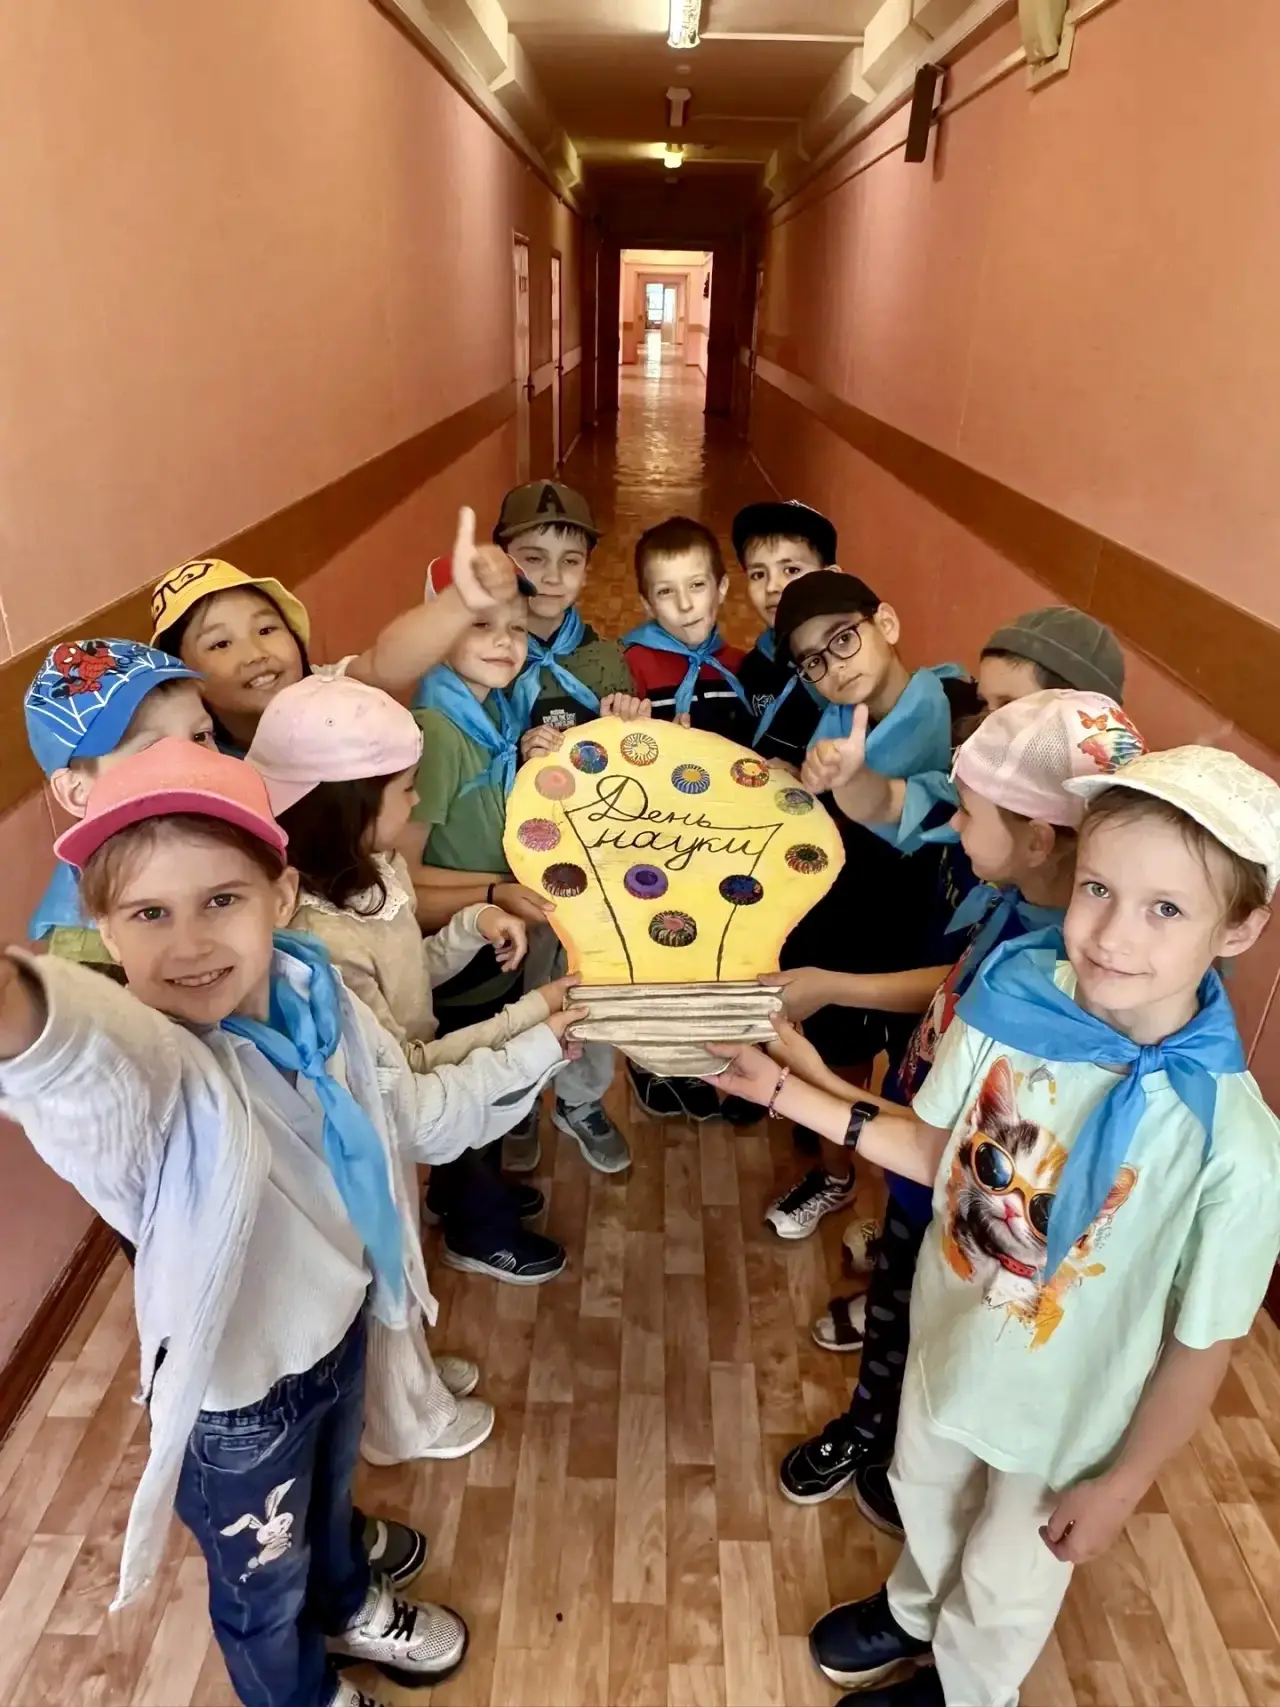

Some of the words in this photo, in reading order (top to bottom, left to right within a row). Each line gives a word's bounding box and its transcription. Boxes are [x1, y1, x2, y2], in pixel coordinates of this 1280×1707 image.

[536, 484, 567, 514] A
[587, 774, 713, 829] День
[588, 827, 761, 871] науки
